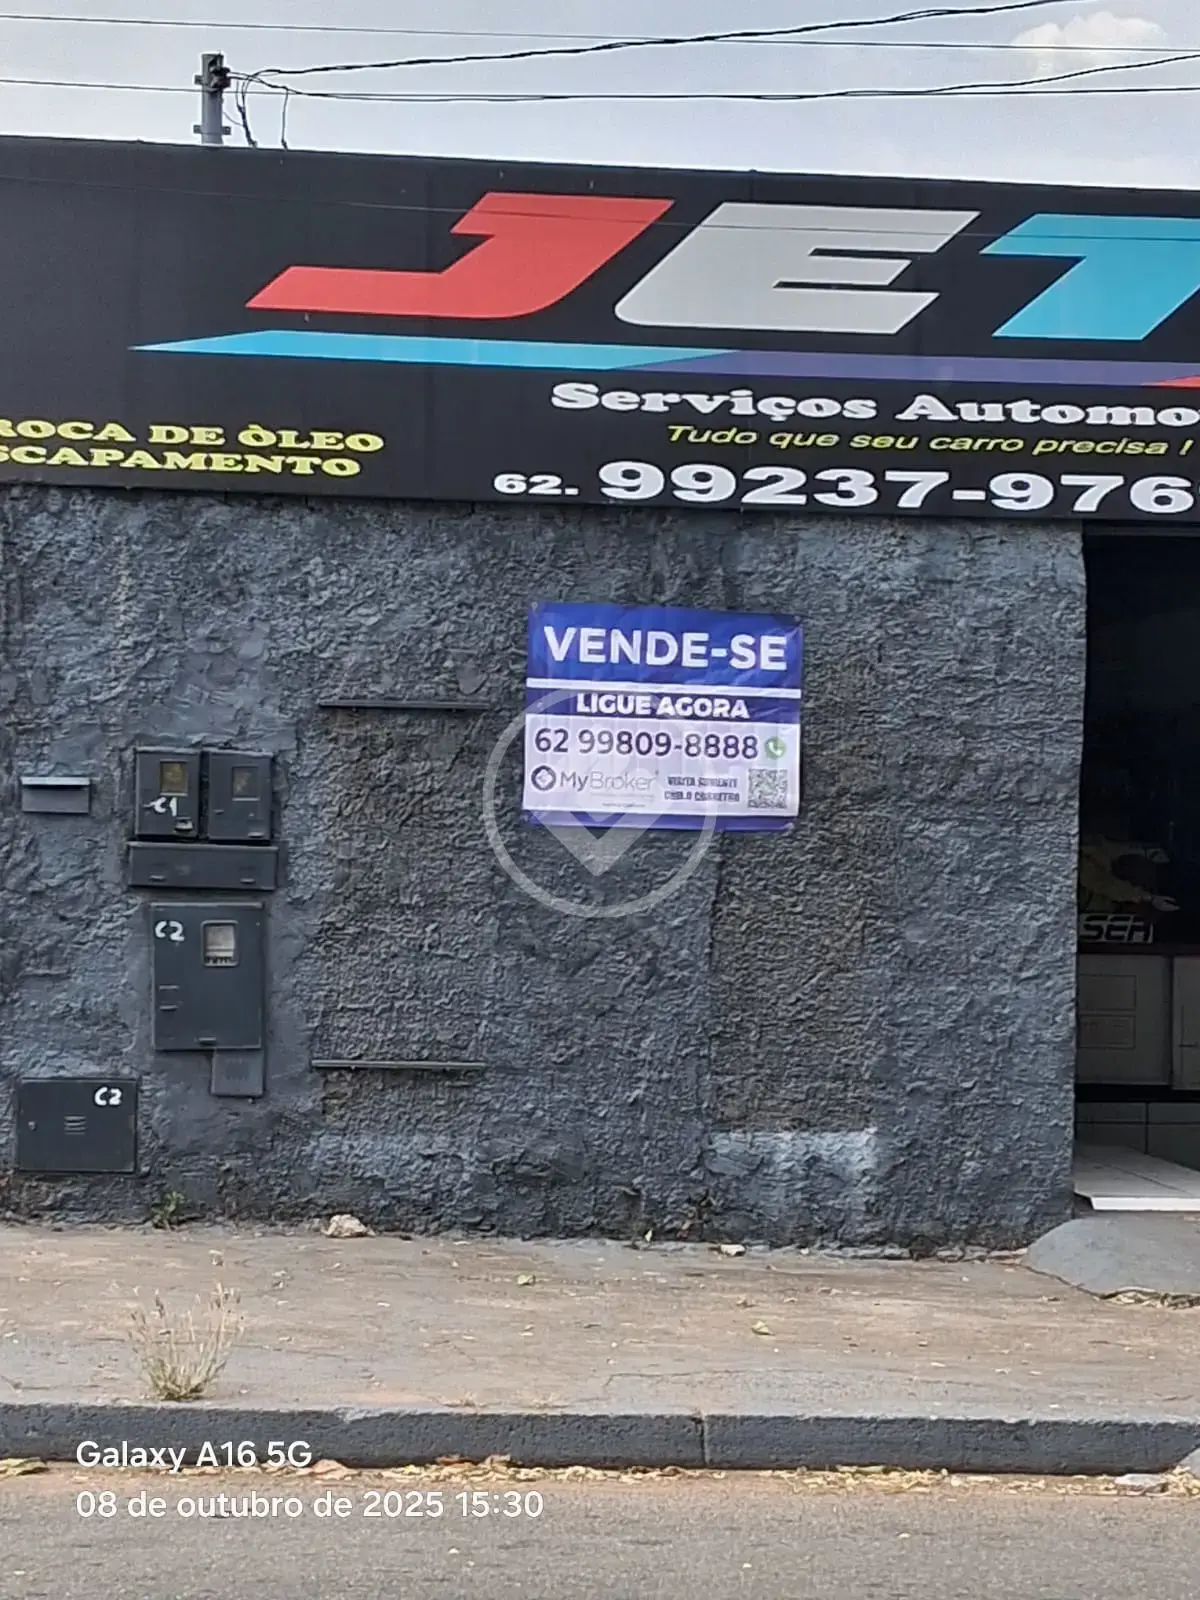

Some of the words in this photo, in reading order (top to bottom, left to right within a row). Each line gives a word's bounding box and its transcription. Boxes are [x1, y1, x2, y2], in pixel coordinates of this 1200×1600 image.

[246, 191, 1200, 341] JET
[551, 381, 877, 422] Serviços
[895, 393, 1200, 428] Automo
[148, 425, 226, 446] DE
[237, 424, 384, 452] ÒLEO
[668, 425, 758, 444] Tudo
[769, 432, 840, 449] que
[849, 434, 919, 449] seu
[929, 437, 1024, 452] carro
[1031, 437, 1169, 456] precisa
[1179, 439, 1194, 456] !
[493, 473, 579, 496] 62.
[598, 460, 1200, 514] 99237-976
[543, 626, 788, 671] VENDE-SE
[576, 692, 653, 715] LIGUE
[655, 696, 750, 719] AGORA
[534, 728, 569, 753] 62
[578, 729, 758, 760] 99809-8888
[560, 770, 655, 792] MyBroker
[155, 920, 185, 942] C2
